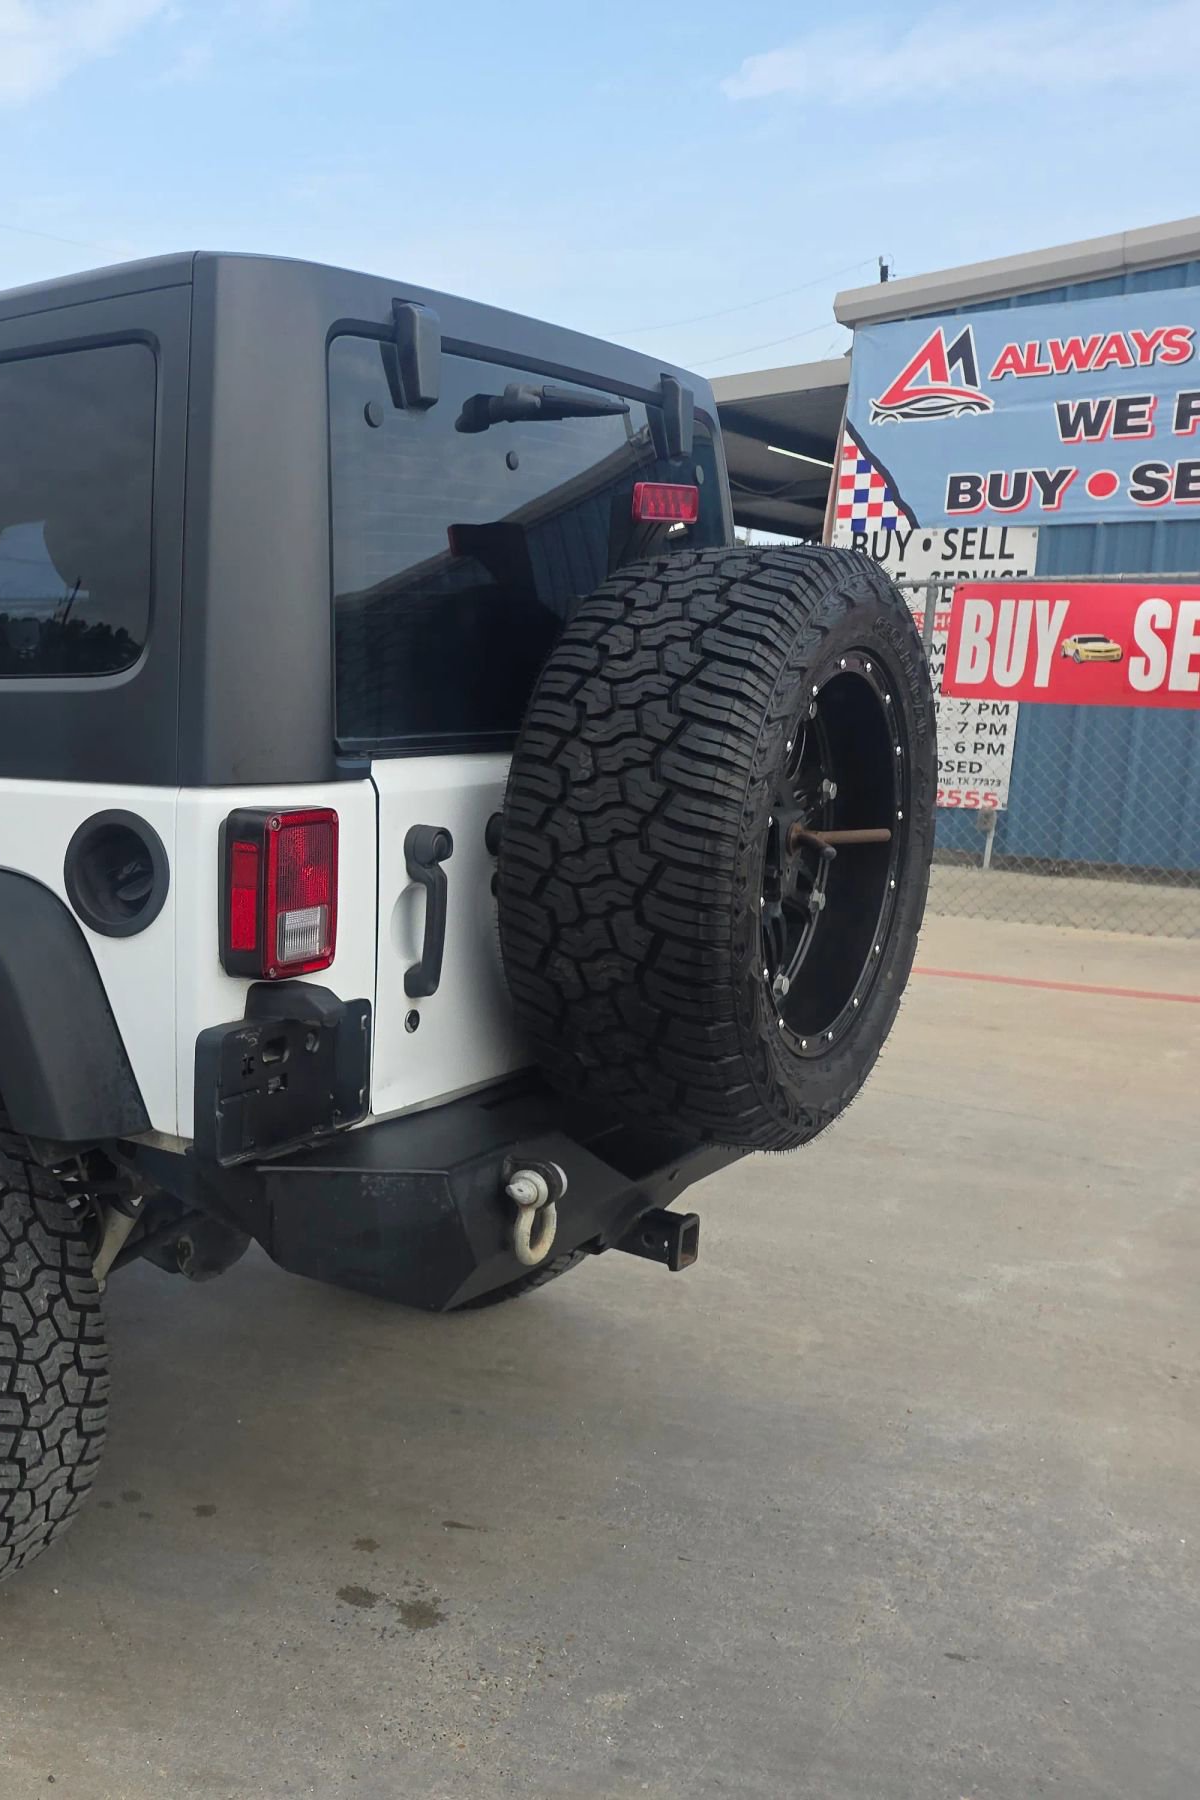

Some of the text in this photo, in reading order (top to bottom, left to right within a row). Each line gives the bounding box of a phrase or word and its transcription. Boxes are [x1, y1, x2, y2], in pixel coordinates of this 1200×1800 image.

[988, 325, 1196, 381] ALWAYS
[1054, 394, 1158, 445] WE
[944, 466, 1079, 516] BUY
[851, 527, 1015, 562] BUY SELL
[954, 599, 1071, 688] BUY
[960, 702, 971, 715] 7
[978, 703, 1010, 716] PM
[957, 722, 969, 734] 7
[976, 722, 1008, 736] PM
[955, 742, 966, 754] 6
[973, 742, 1005, 756] PM
[938, 760, 983, 774] SED
